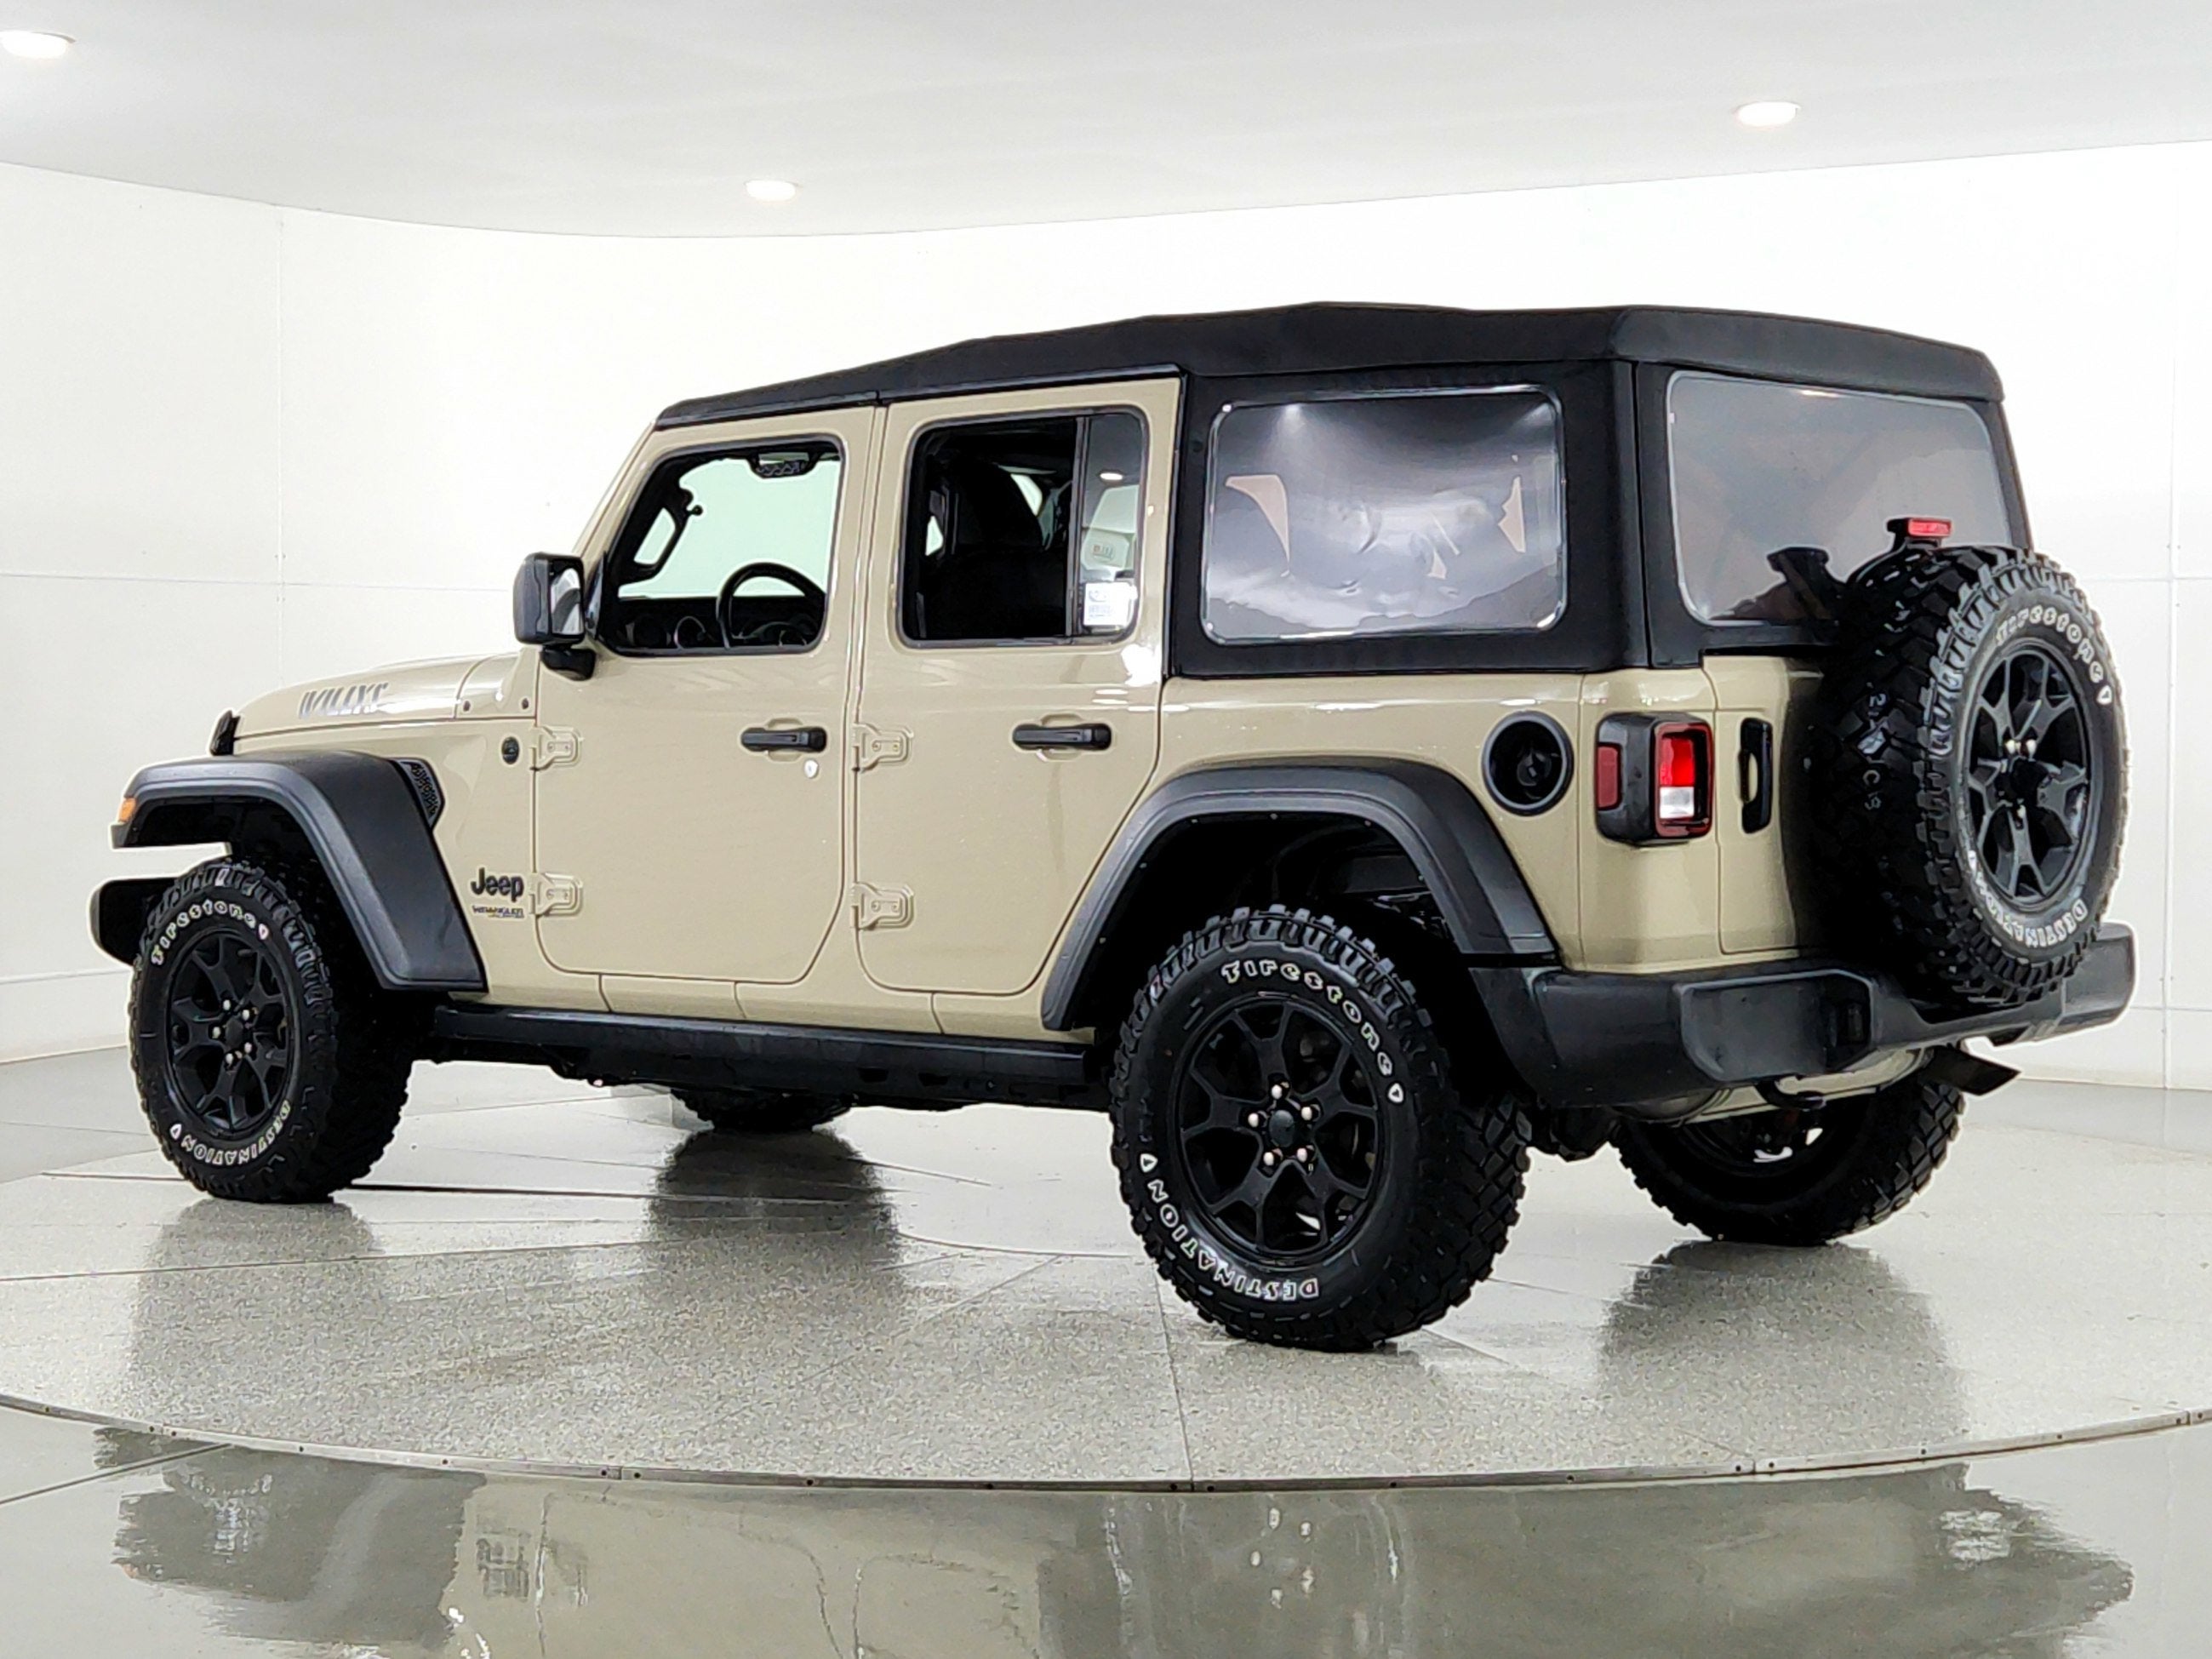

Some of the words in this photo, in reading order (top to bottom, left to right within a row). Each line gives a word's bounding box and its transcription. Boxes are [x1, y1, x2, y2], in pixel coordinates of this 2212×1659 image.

[1996, 604, 2104, 684] Firestone
[471, 867, 524, 903] Jeep
[151, 898, 256, 965] Firestone
[1221, 959, 1393, 1077] Firestone
[180, 1099, 291, 1165] DESTINATION
[1147, 1179, 1319, 1301] DESTINATION
